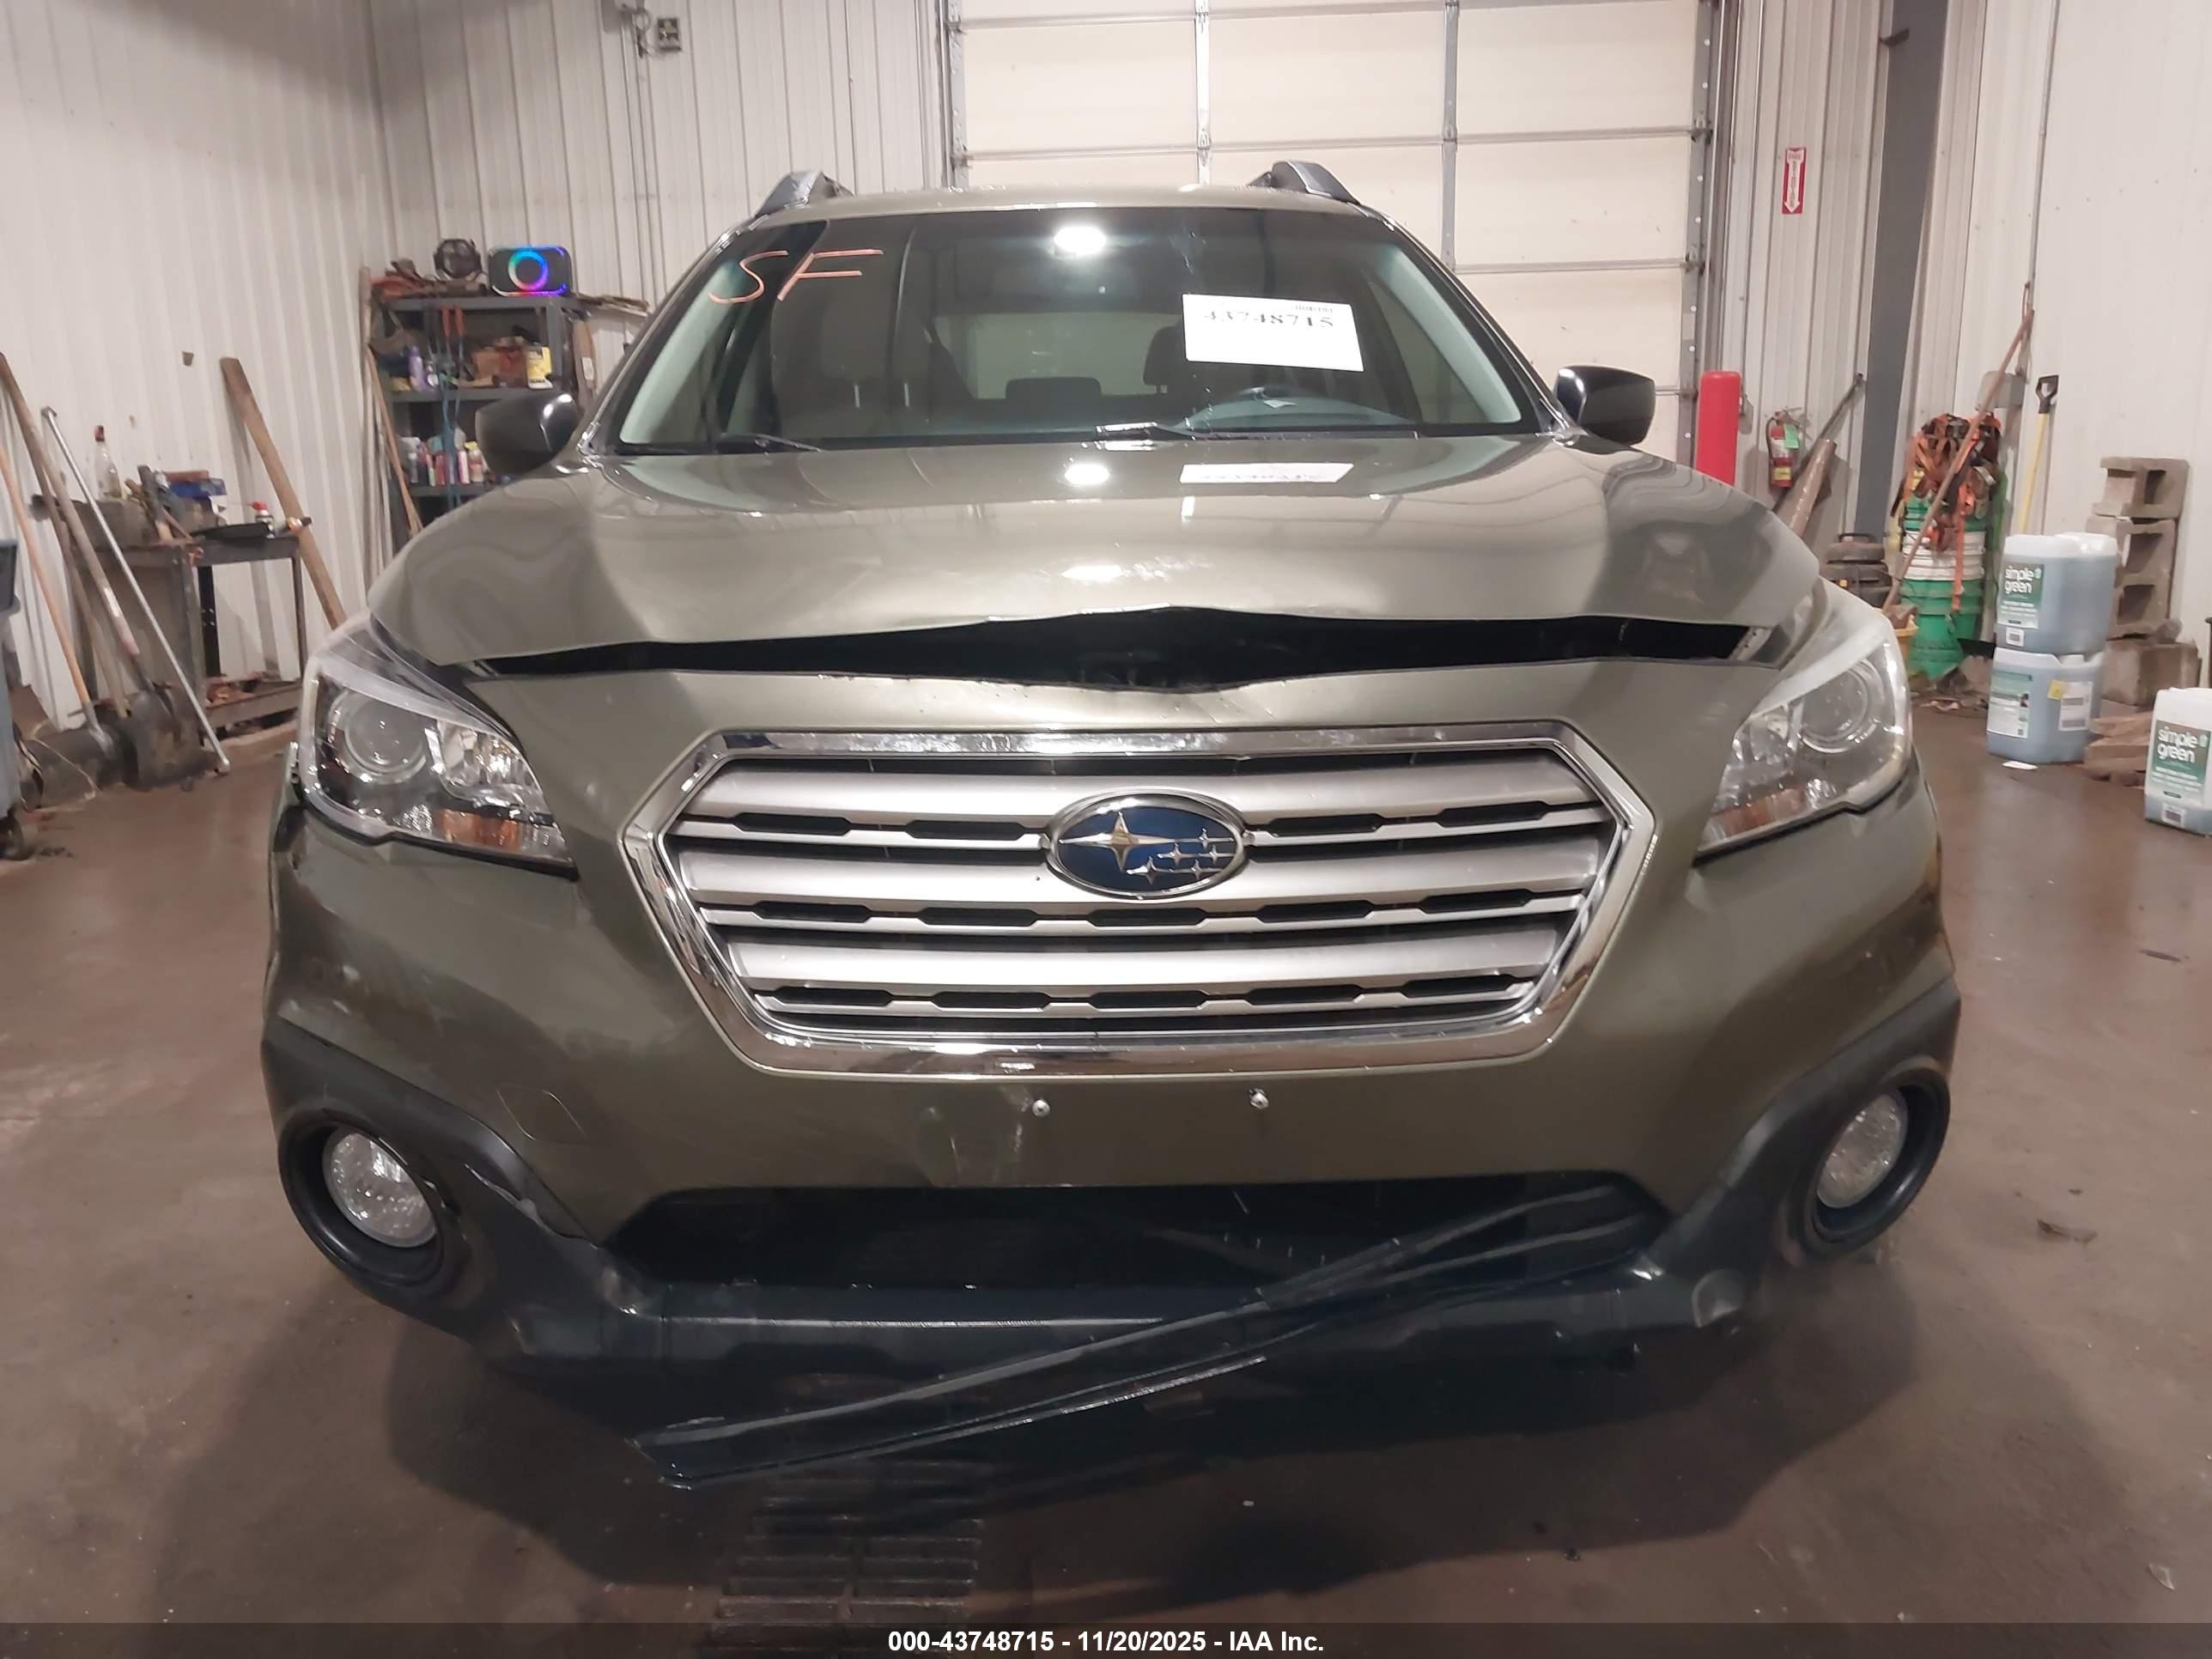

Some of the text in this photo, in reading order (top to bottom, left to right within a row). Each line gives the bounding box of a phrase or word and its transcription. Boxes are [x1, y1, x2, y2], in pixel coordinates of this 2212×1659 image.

[2005, 565, 2034, 581] simple
[2004, 580, 2033, 594] green
[2157, 726, 2198, 748] simple
[2157, 743, 2196, 763] green
